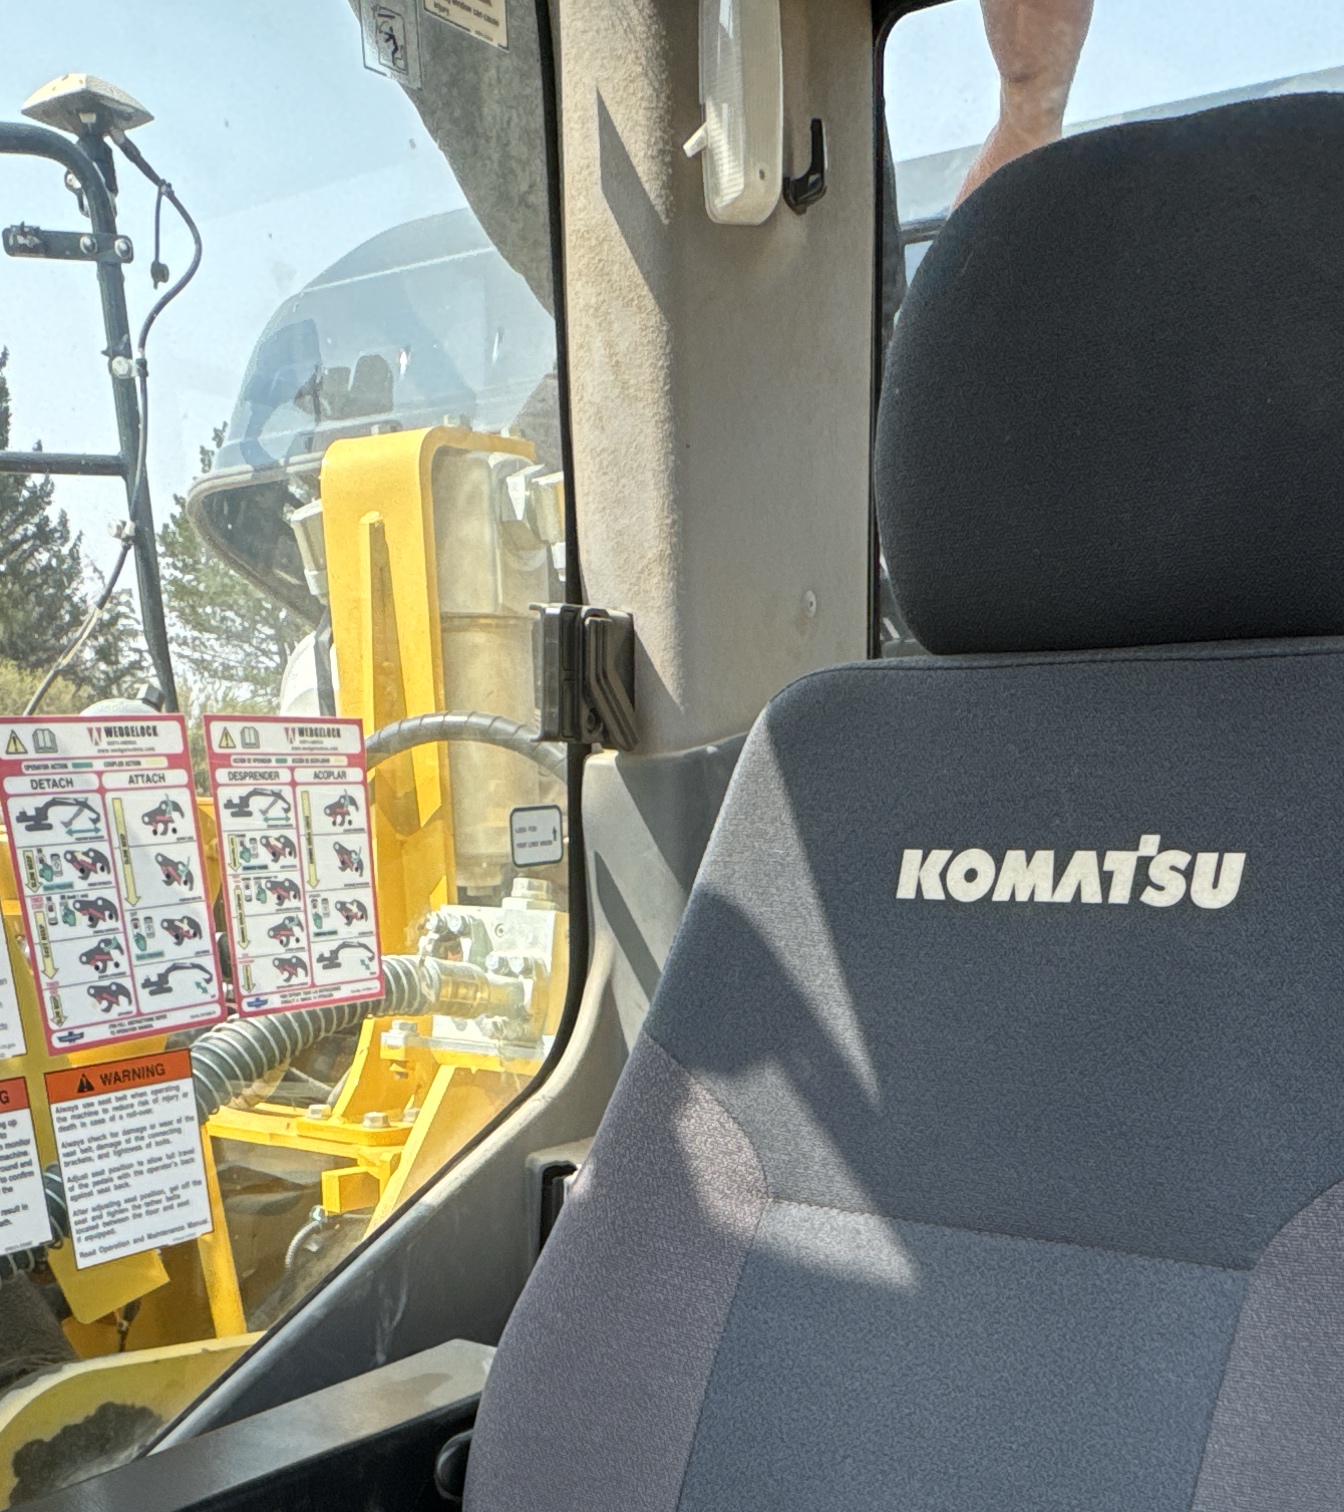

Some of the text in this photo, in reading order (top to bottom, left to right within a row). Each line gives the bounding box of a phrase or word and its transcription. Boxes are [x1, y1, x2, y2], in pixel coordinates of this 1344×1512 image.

[128, 773, 166, 785] ATTACH
[228, 770, 280, 782] DESPRENDER
[313, 770, 347, 780] ACOPLAR
[30, 777, 74, 790] DETACH
[896, 834, 1246, 909] KOMATSU
[100, 1063, 166, 1086] WARNING
